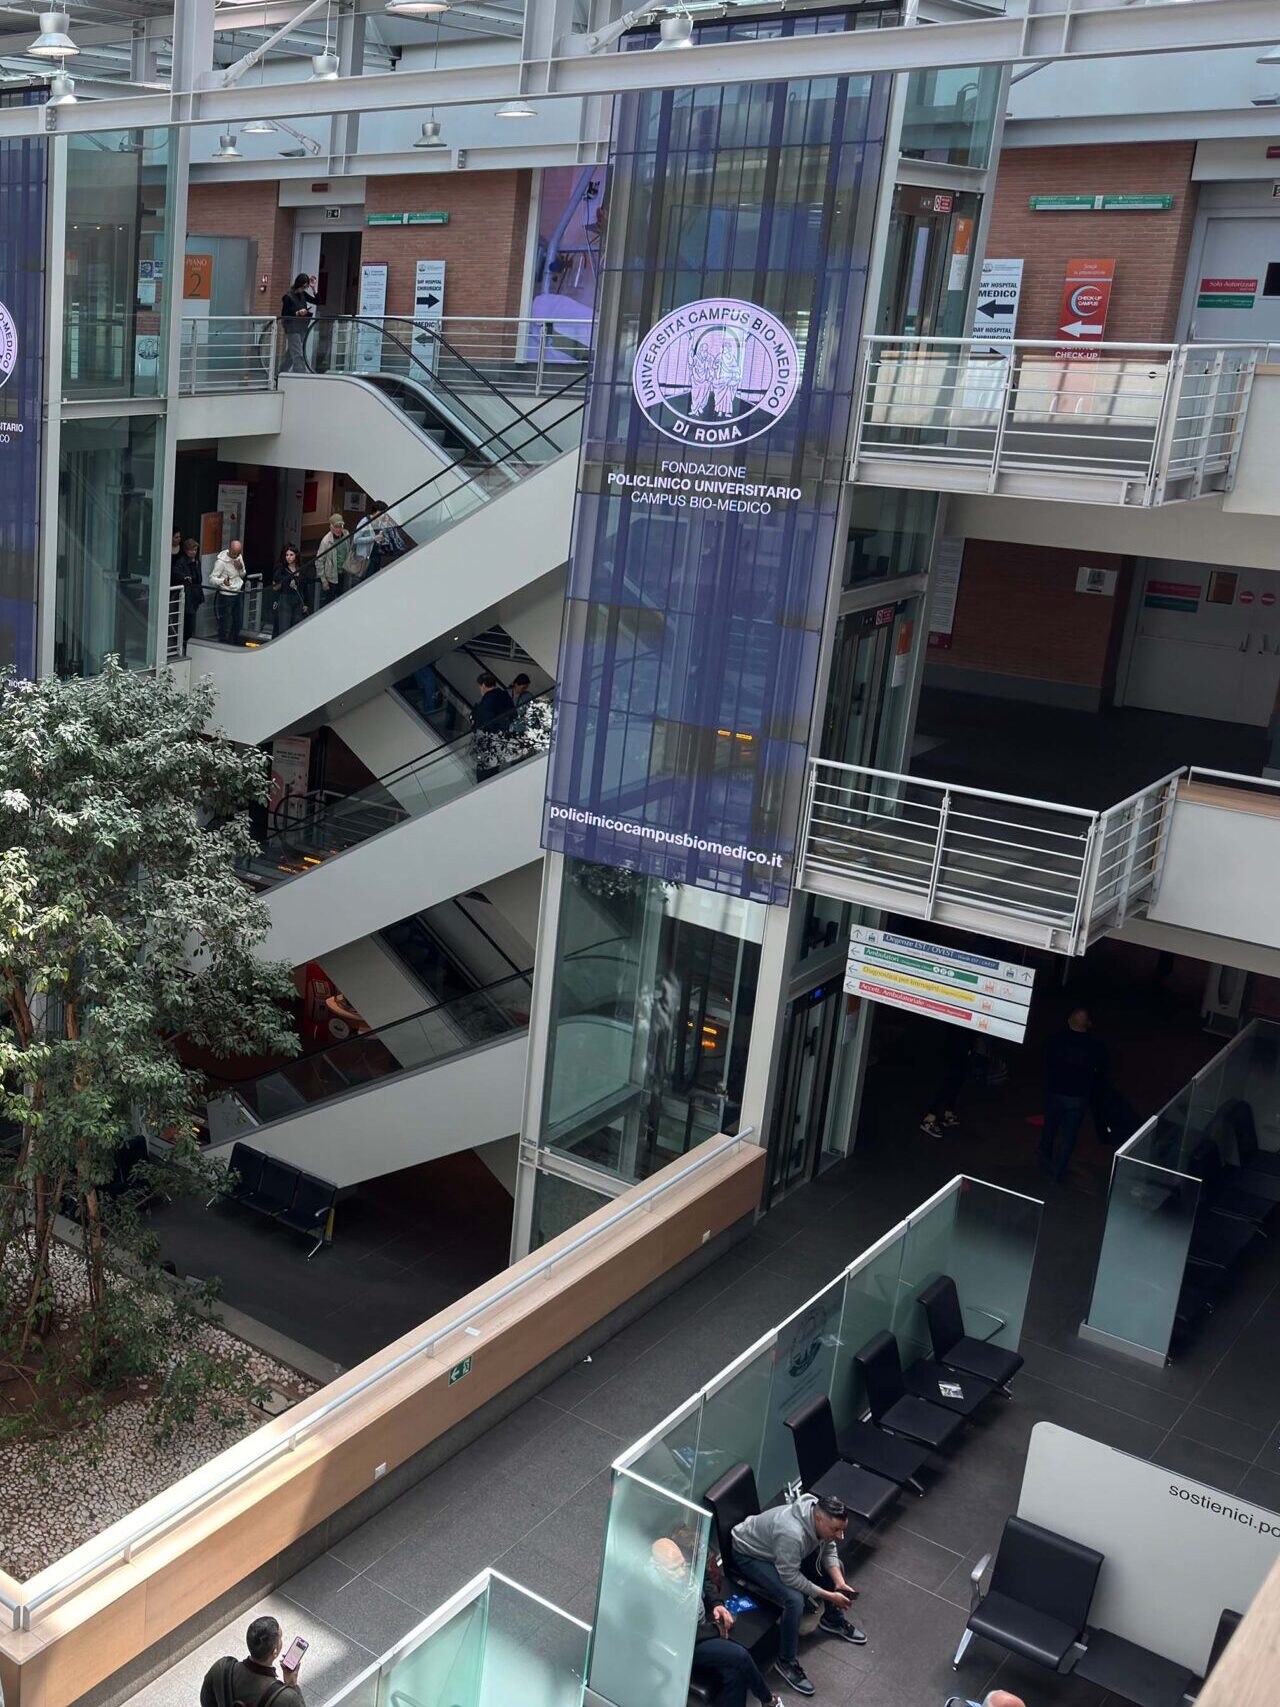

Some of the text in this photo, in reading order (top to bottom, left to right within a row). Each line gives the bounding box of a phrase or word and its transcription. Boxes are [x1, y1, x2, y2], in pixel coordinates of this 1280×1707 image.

[189, 273, 201, 296] 2
[978, 290, 1017, 298] MEDICO
[688, 308, 750, 325] CAMPUS
[752, 318, 790, 409] BIO-MEDICO
[1055, 352, 1098, 360] CHECK-UP
[672, 420, 742, 442] DI ROMA
[661, 460, 747, 479] FONDAZIONE
[607, 472, 802, 500] POLICLINICO UNIVERSITARIO
[630, 491, 771, 515] CAMPUS BIO-MEDICO
[550, 805, 784, 869] policlinicocampusbiomedico.it
[866, 948, 900, 963] Ambulatori
[885, 934, 914, 948] Degenze
[932, 945, 955, 958] OVEST
[882, 988, 925, 1006] Ambulatoriale
